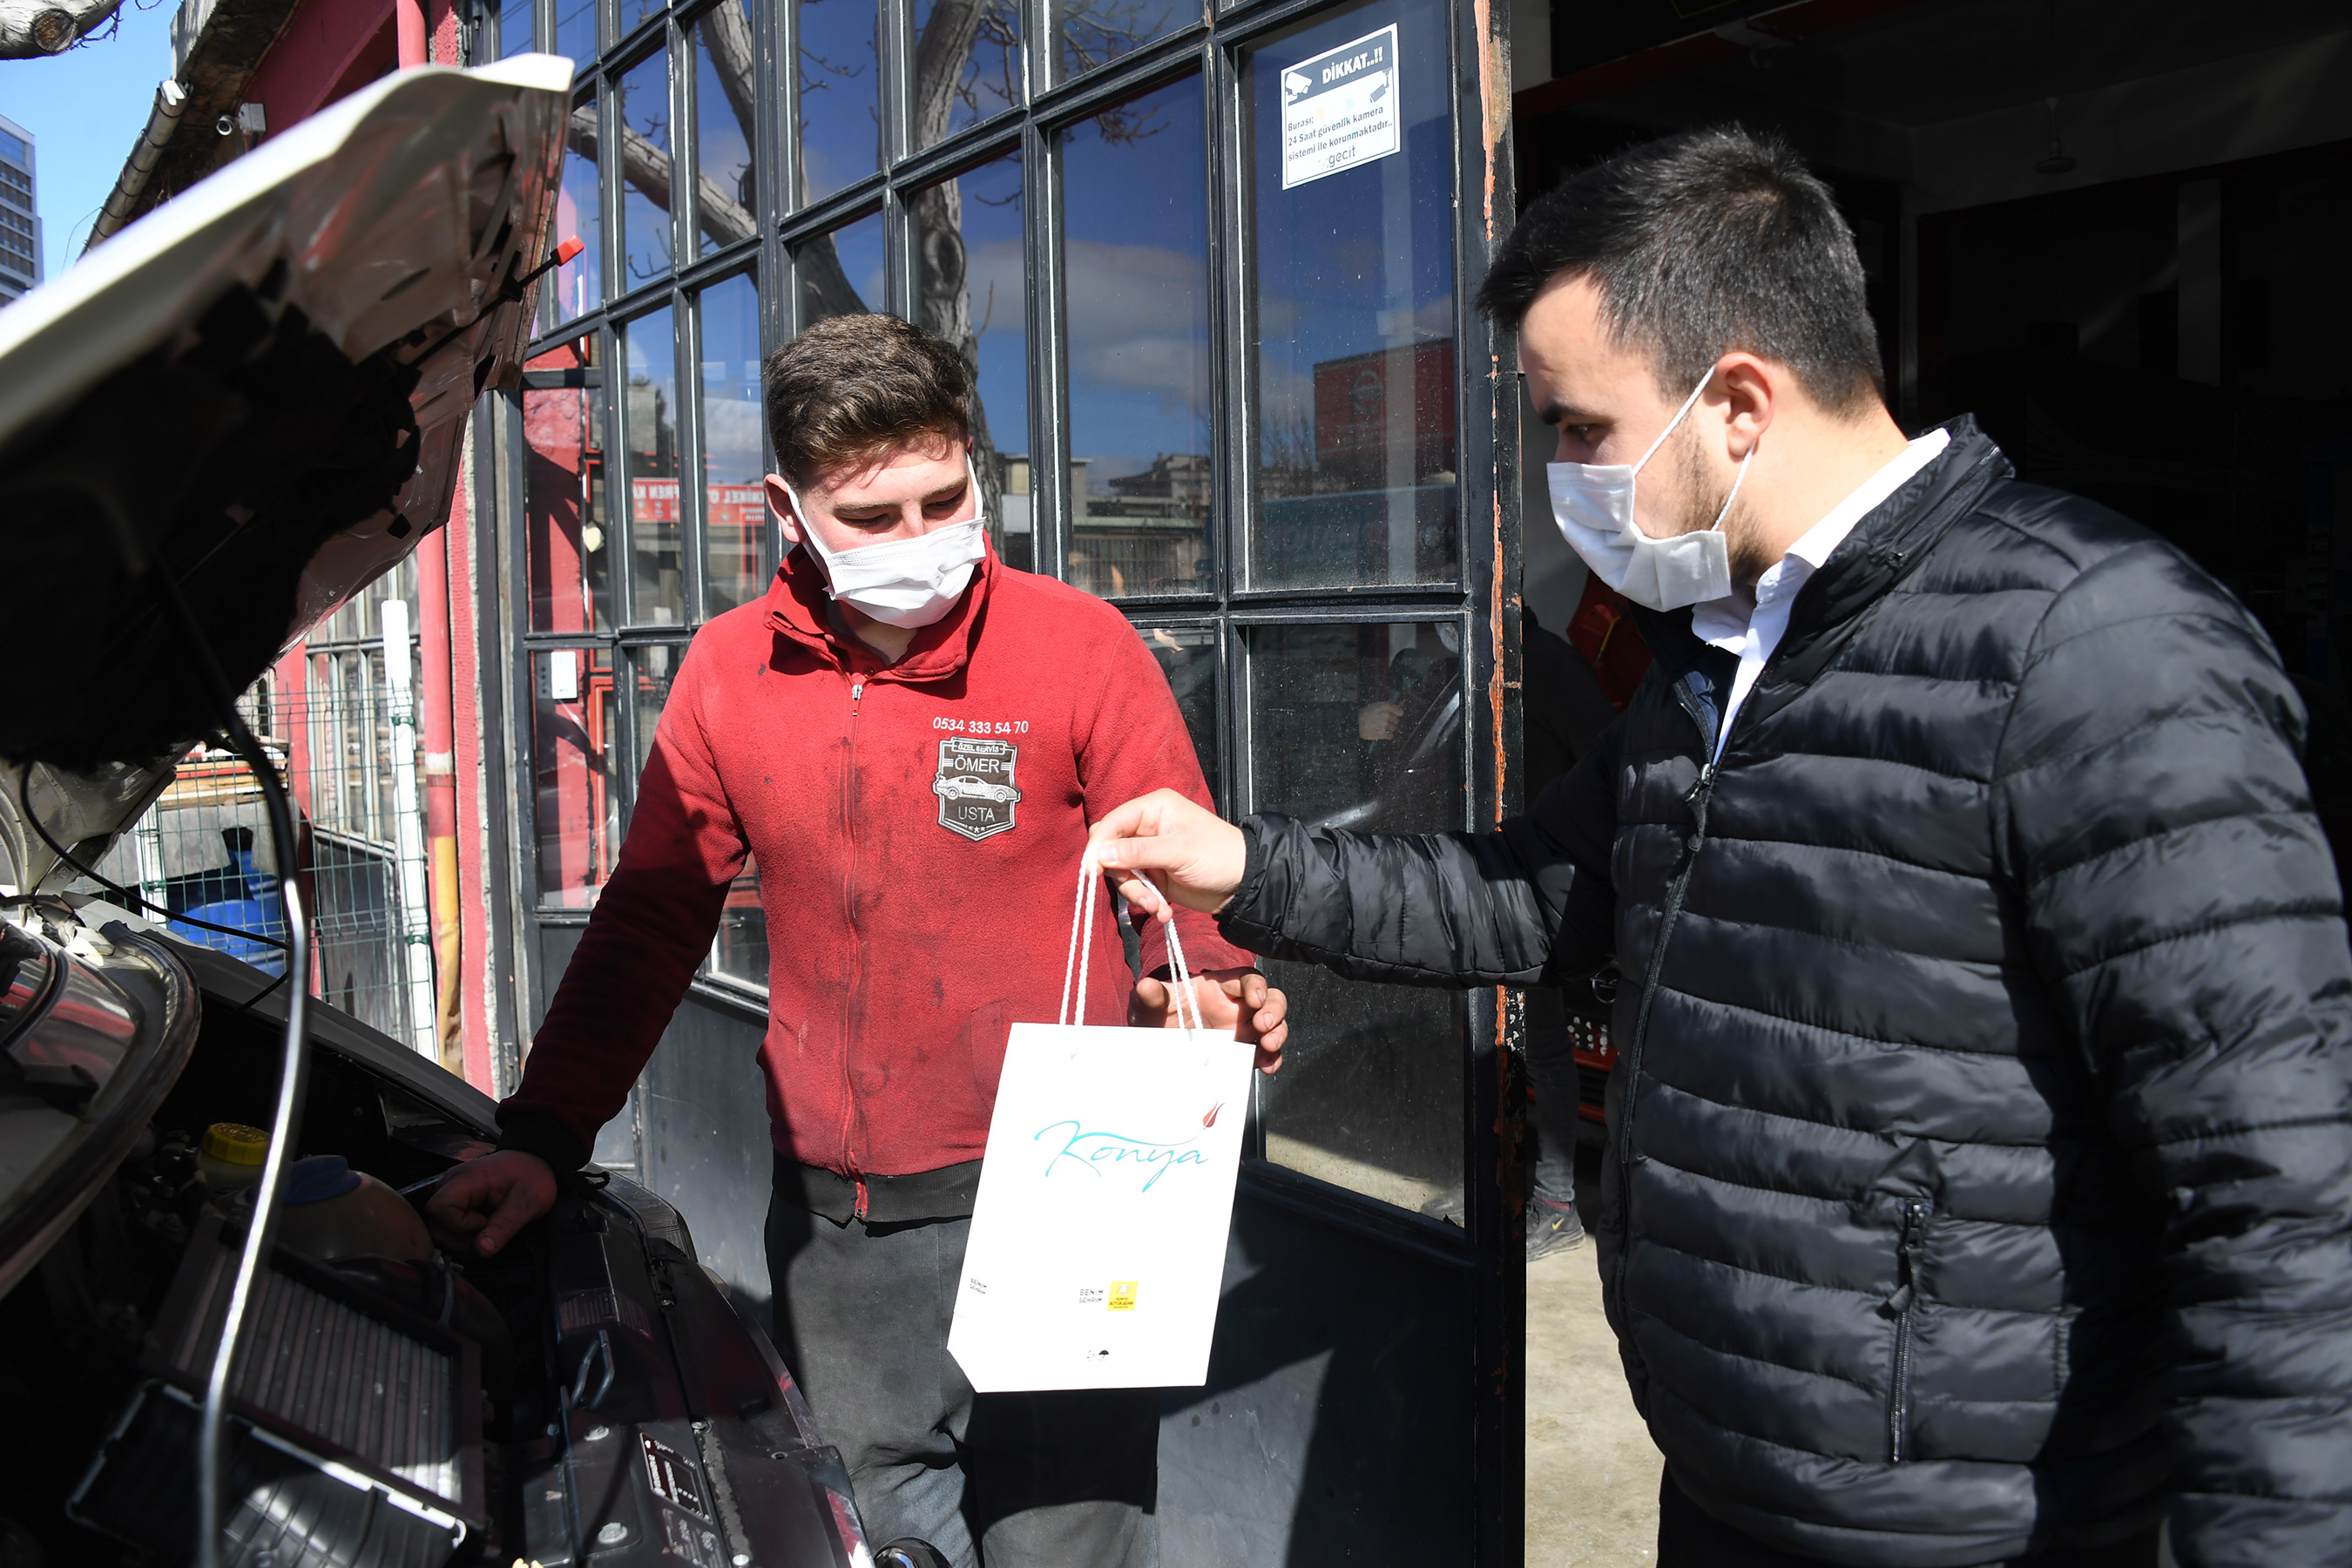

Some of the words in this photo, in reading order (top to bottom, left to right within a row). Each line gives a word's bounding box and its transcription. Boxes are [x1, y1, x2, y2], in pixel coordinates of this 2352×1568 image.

[1321, 46, 1383, 84] DİKKAT..!!
[1288, 117, 1314, 132] Burası;
[1288, 135, 1297, 146] 24
[1299, 130, 1316, 144] Saat
[1318, 117, 1351, 138] güvenlik
[1353, 106, 1383, 124] kamera
[1288, 145, 1316, 161] sistemi
[1317, 141, 1327, 152] ile
[932, 717, 964, 732] 0534
[968, 720, 991, 733] 333
[995, 721, 1012, 734] 54
[1013, 720, 1029, 733] 70
[955, 754, 1001, 774] ÖMER
[958, 806, 996, 822] USTA
[1034, 1120, 1209, 1193] Konya
